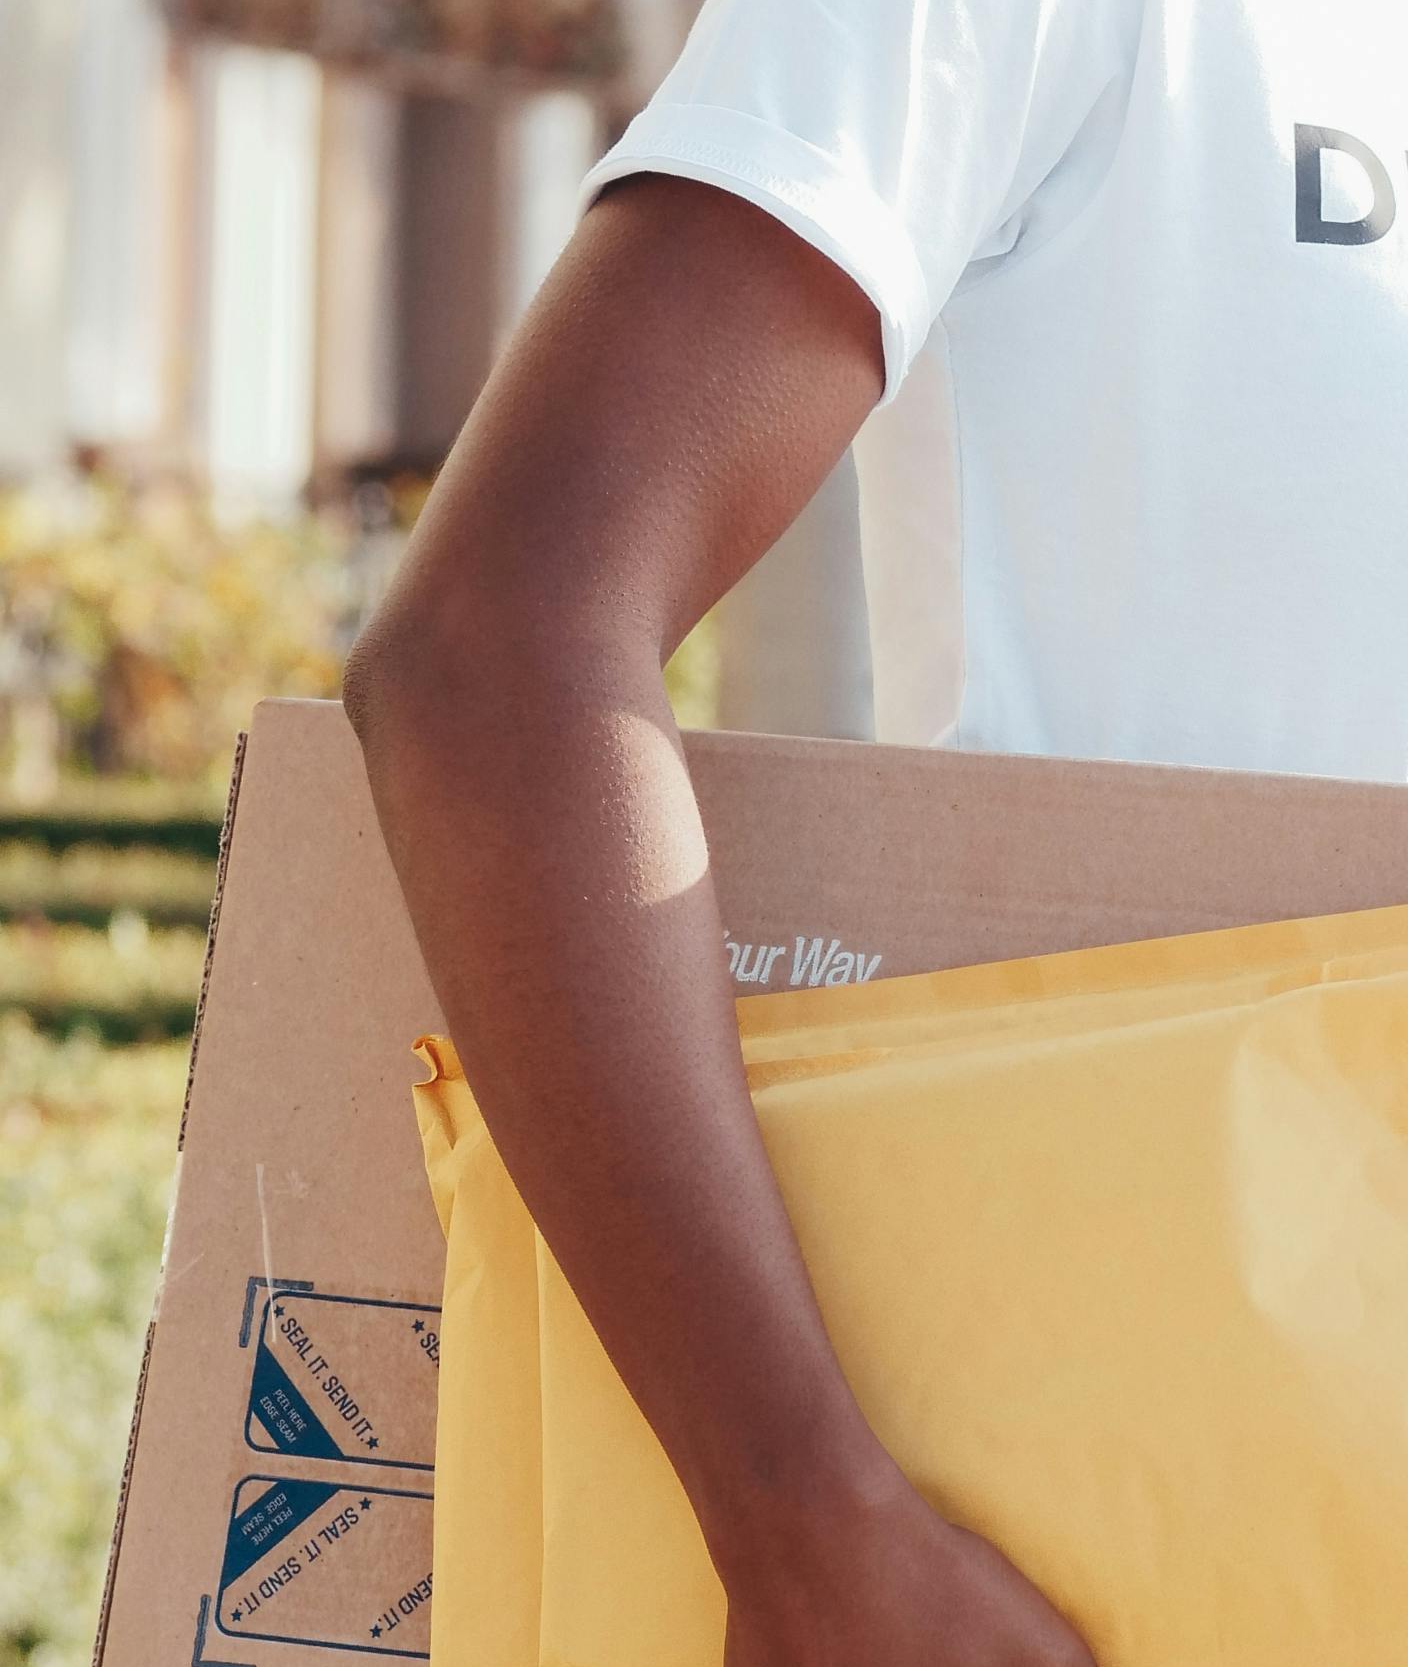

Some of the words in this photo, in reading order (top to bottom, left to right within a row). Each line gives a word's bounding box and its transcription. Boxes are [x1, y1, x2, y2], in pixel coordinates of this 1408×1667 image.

[281, 1317, 314, 1362] SEAL
[308, 1356, 329, 1380] IT.
[322, 1376, 360, 1422] SEND
[352, 1417, 373, 1442] IT.
[260, 1396, 280, 1420] EDGE
[276, 1419, 297, 1443] SEAM
[273, 1389, 290, 1411] PEEL
[287, 1408, 307, 1432] HERE
[264, 1493, 287, 1515] EDGE
[241, 1512, 265, 1535] SEAM
[271, 1506, 293, 1526] PEEL
[318, 1507, 359, 1544] SEAL
[250, 1524, 274, 1546] HERE
[299, 1539, 321, 1562] IT.
[258, 1556, 302, 1599] SEND
[238, 1592, 260, 1615] IT.
[377, 1607, 401, 1631] IT.
